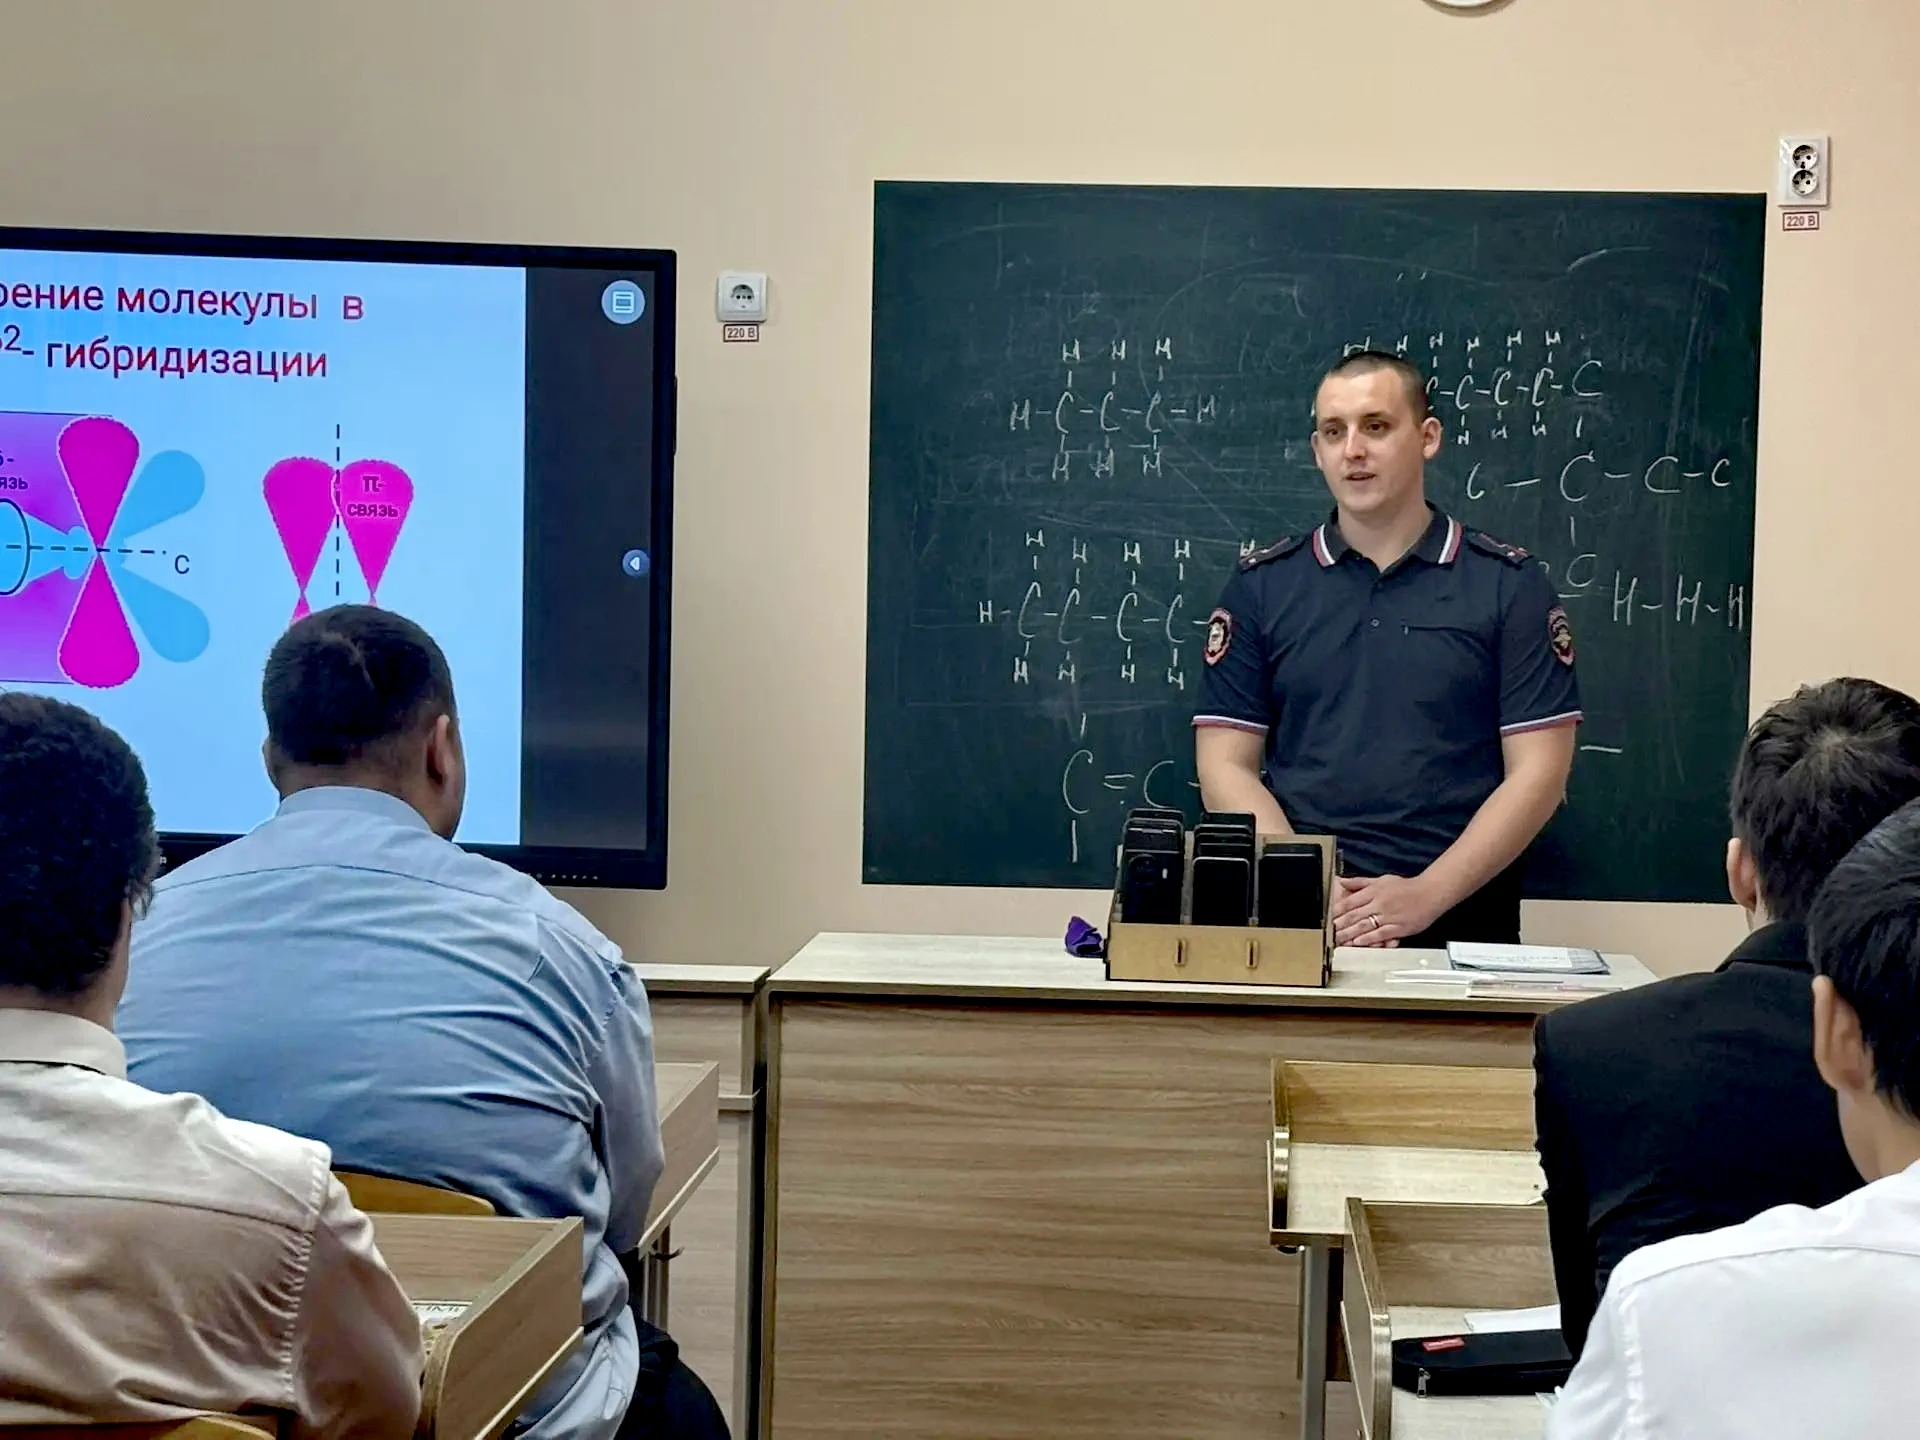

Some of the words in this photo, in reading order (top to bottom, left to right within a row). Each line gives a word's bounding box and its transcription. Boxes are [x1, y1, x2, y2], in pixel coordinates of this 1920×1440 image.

[1786, 215, 1805, 227] 220
[117, 287, 317, 326] молекулы
[343, 295, 364, 320] в
[727, 327, 745, 338] 220
[47, 335, 327, 382] гибридизации
[347, 503, 399, 518] связь
